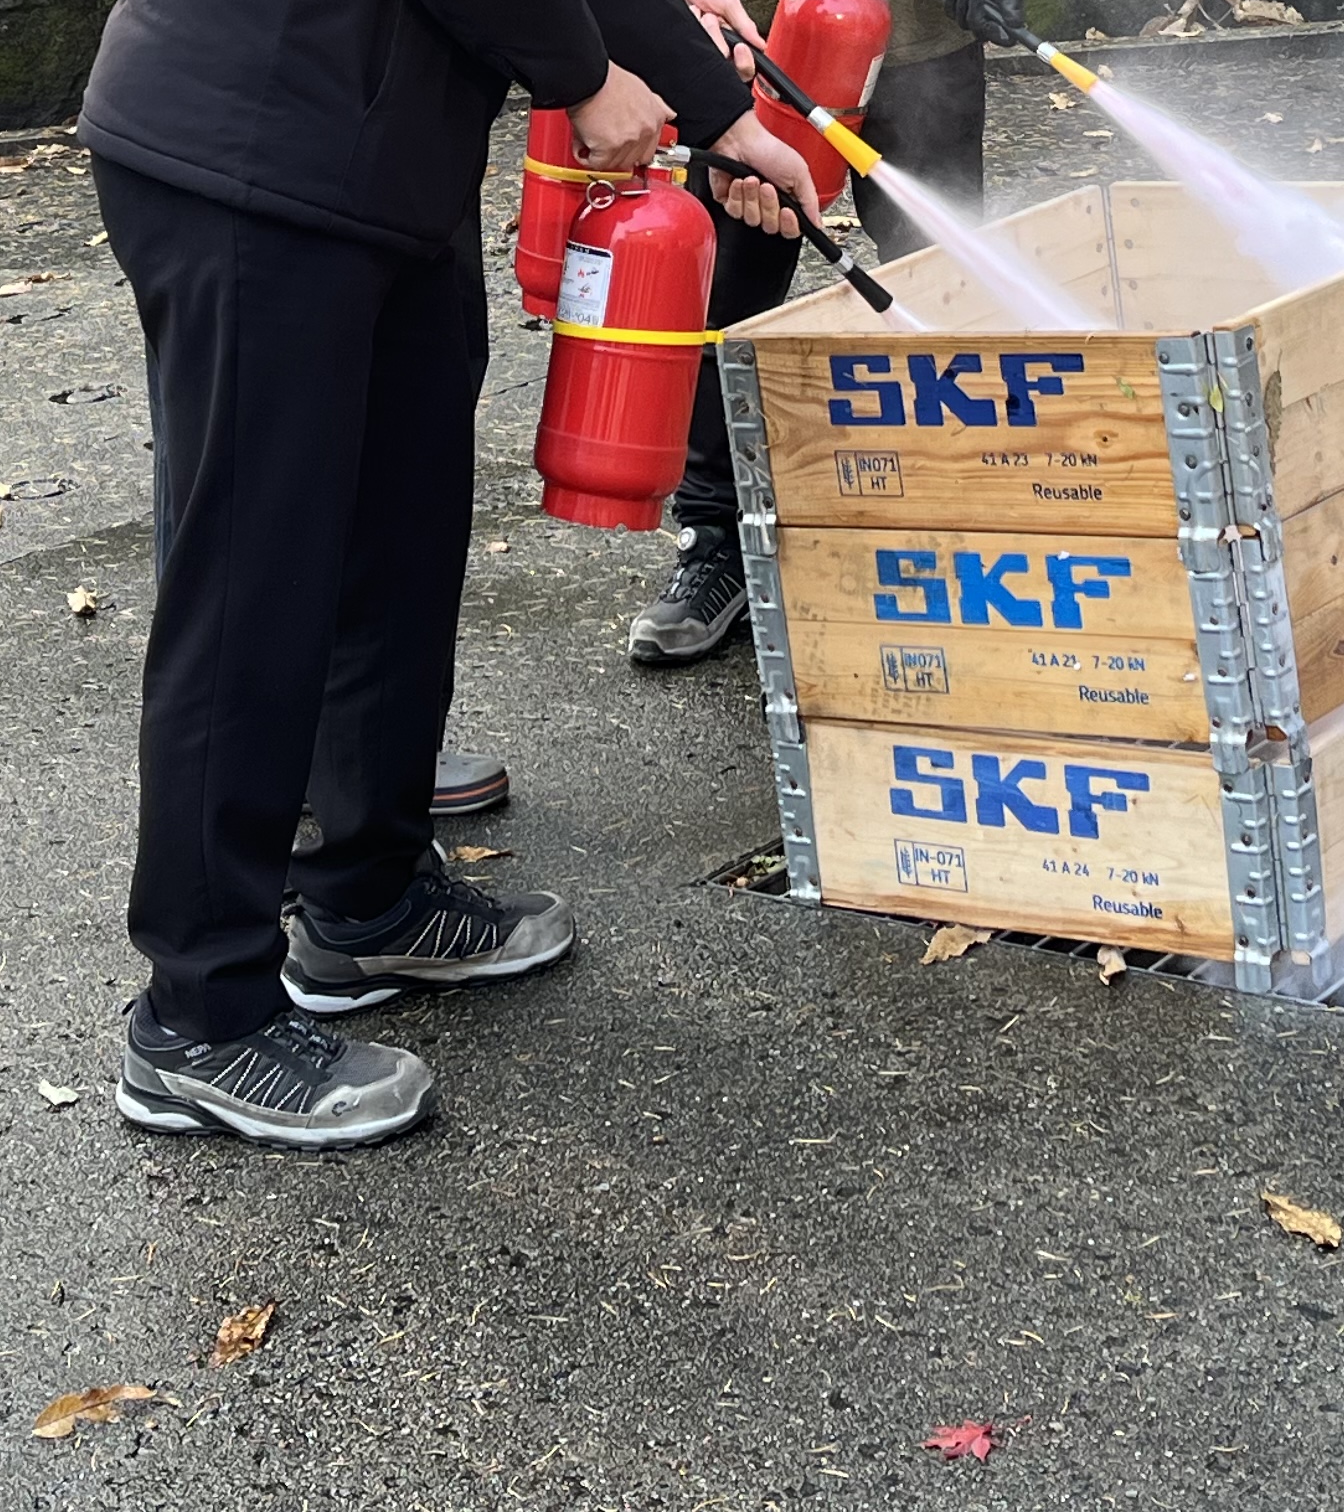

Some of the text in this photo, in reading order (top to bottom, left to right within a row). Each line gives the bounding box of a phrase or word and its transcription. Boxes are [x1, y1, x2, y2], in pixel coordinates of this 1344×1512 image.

[828, 353, 1085, 427] SKF
[981, 452, 1098, 468] 41 A 23 7-20 kN
[870, 475, 888, 491] HT
[1031, 482, 1103, 501] Reusable
[873, 549, 1132, 630] SKF
[1050, 653, 1060, 667] A
[1091, 655, 1125, 671] 7-20
[1127, 656, 1146, 672] kN
[916, 671, 933, 688] HT
[1078, 685, 1150, 705] Reusable
[889, 744, 1151, 840] SKF
[914, 847, 963, 868] IN-071
[930, 868, 951, 885] HT
[1042, 858, 1160, 886] 41 A 24 7-20 kN
[1092, 894, 1163, 920] Reusable
